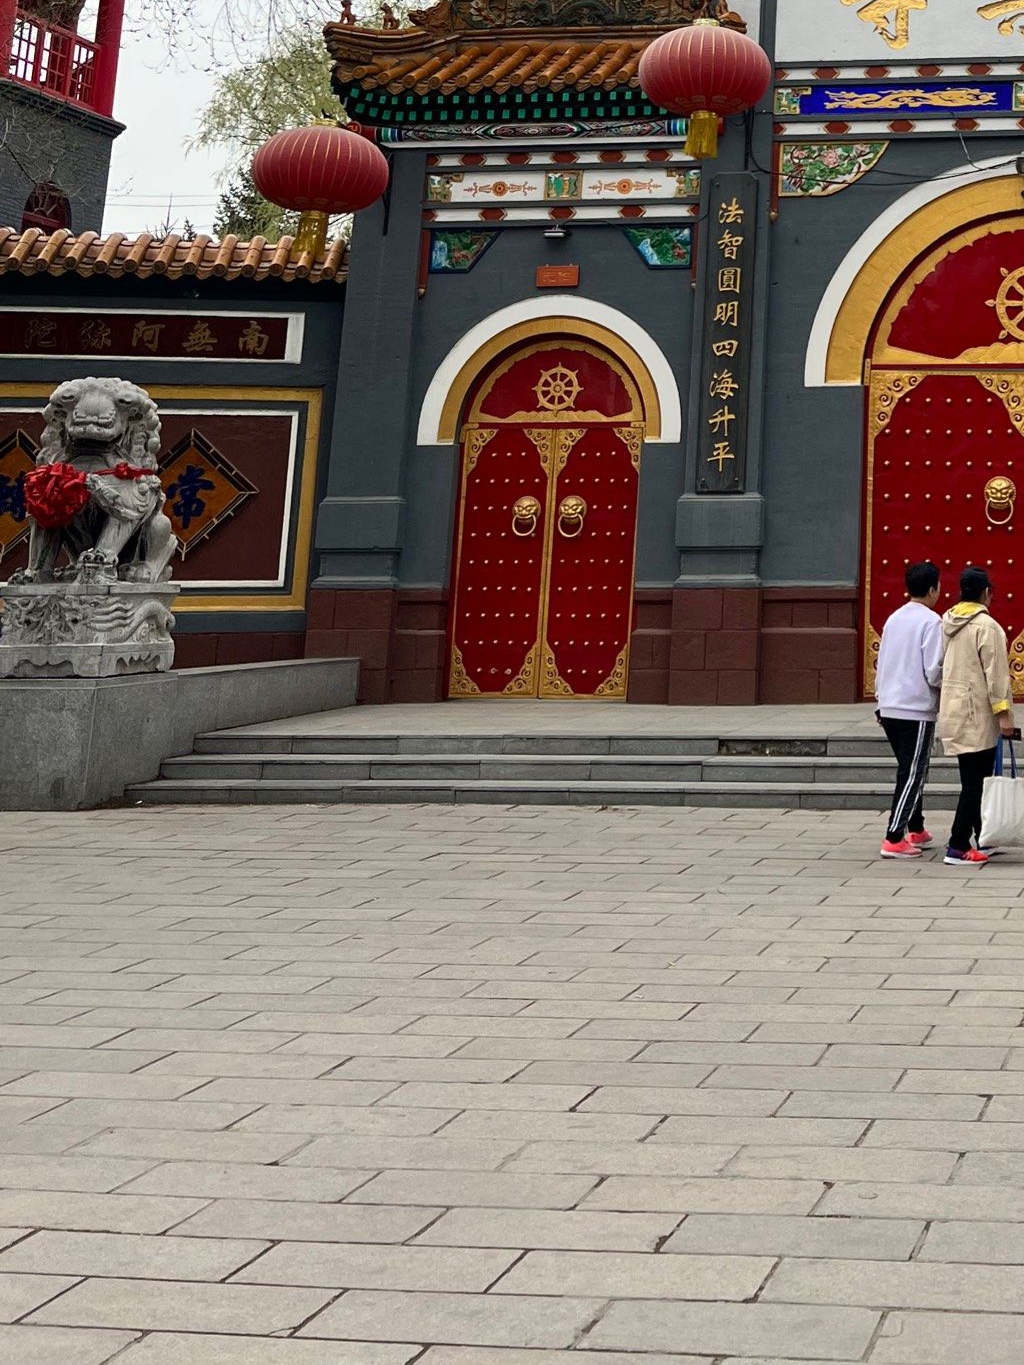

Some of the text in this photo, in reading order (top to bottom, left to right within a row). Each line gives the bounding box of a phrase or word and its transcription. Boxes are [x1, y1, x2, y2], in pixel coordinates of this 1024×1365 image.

[707, 197, 744, 472] 法智圓明四海升平
